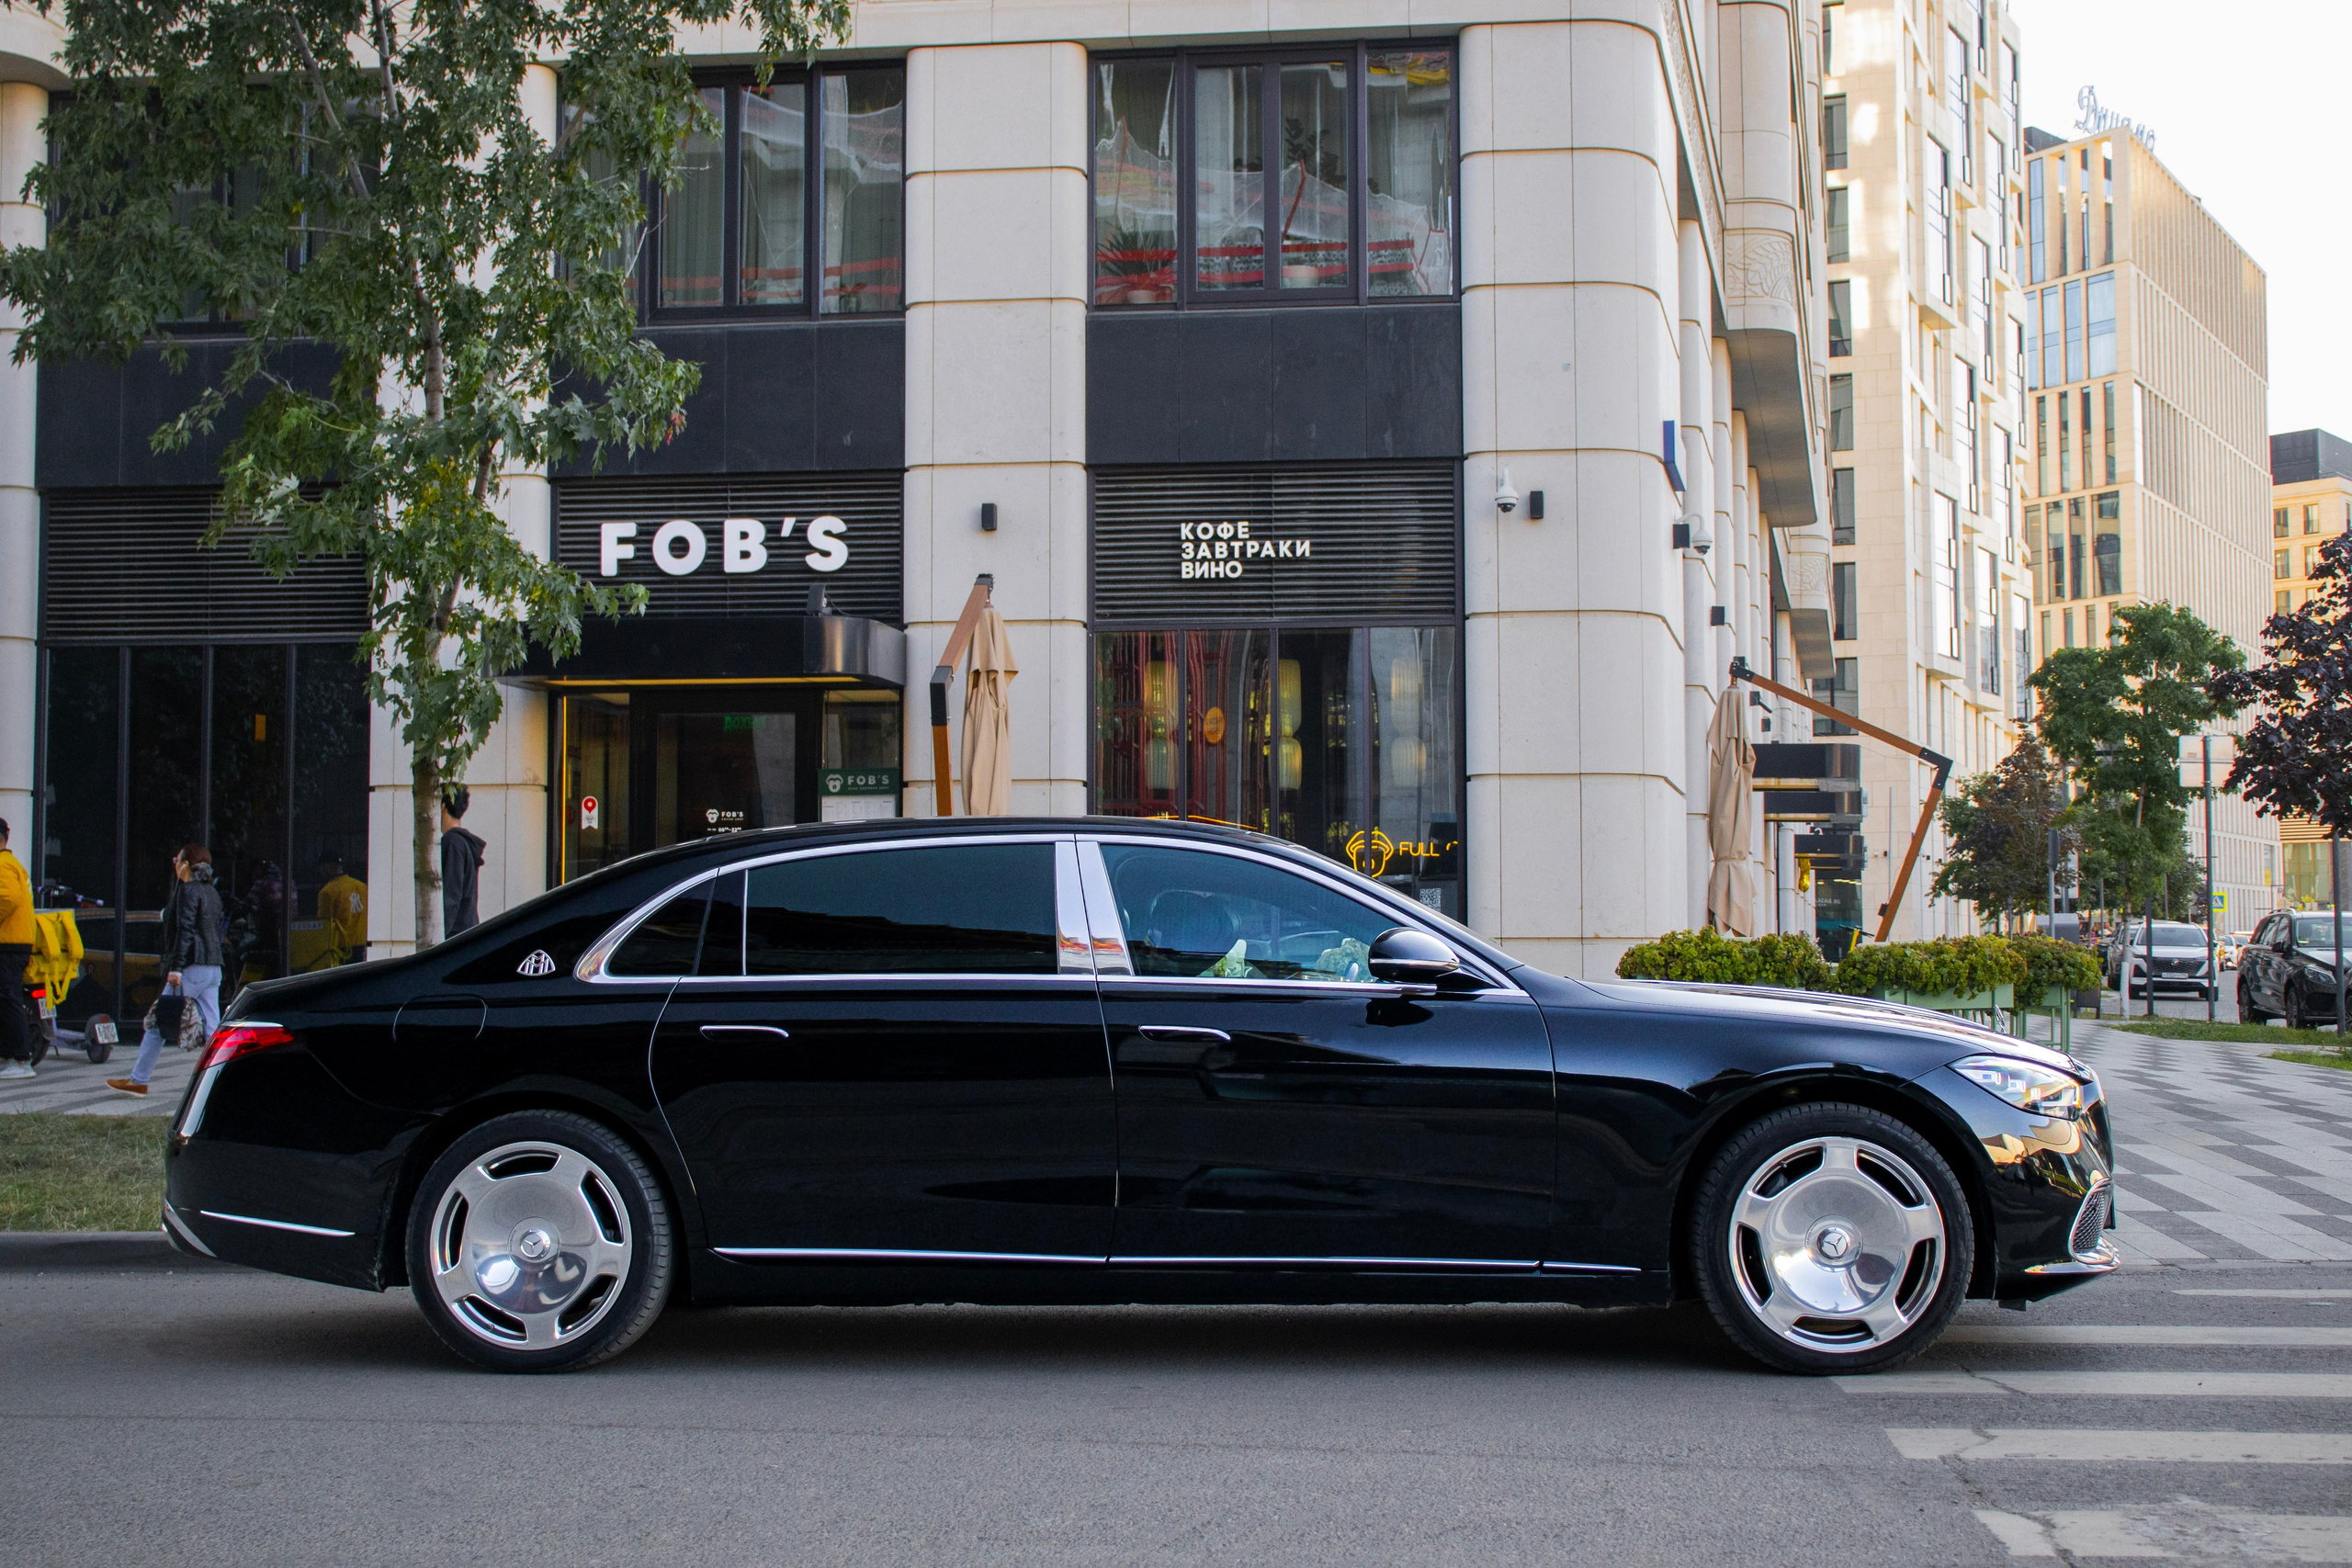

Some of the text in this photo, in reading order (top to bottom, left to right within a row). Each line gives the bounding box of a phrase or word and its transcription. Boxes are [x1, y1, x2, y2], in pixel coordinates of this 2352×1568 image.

[1181, 521, 1250, 540] КОФЕ
[600, 515, 849, 577] FOB'S
[1181, 540, 1310, 559] ЗАВТРАКИ
[1182, 560, 1243, 579] ВИНО
[847, 774, 890, 785] FOB'S
[1399, 840, 1441, 856] FULL
